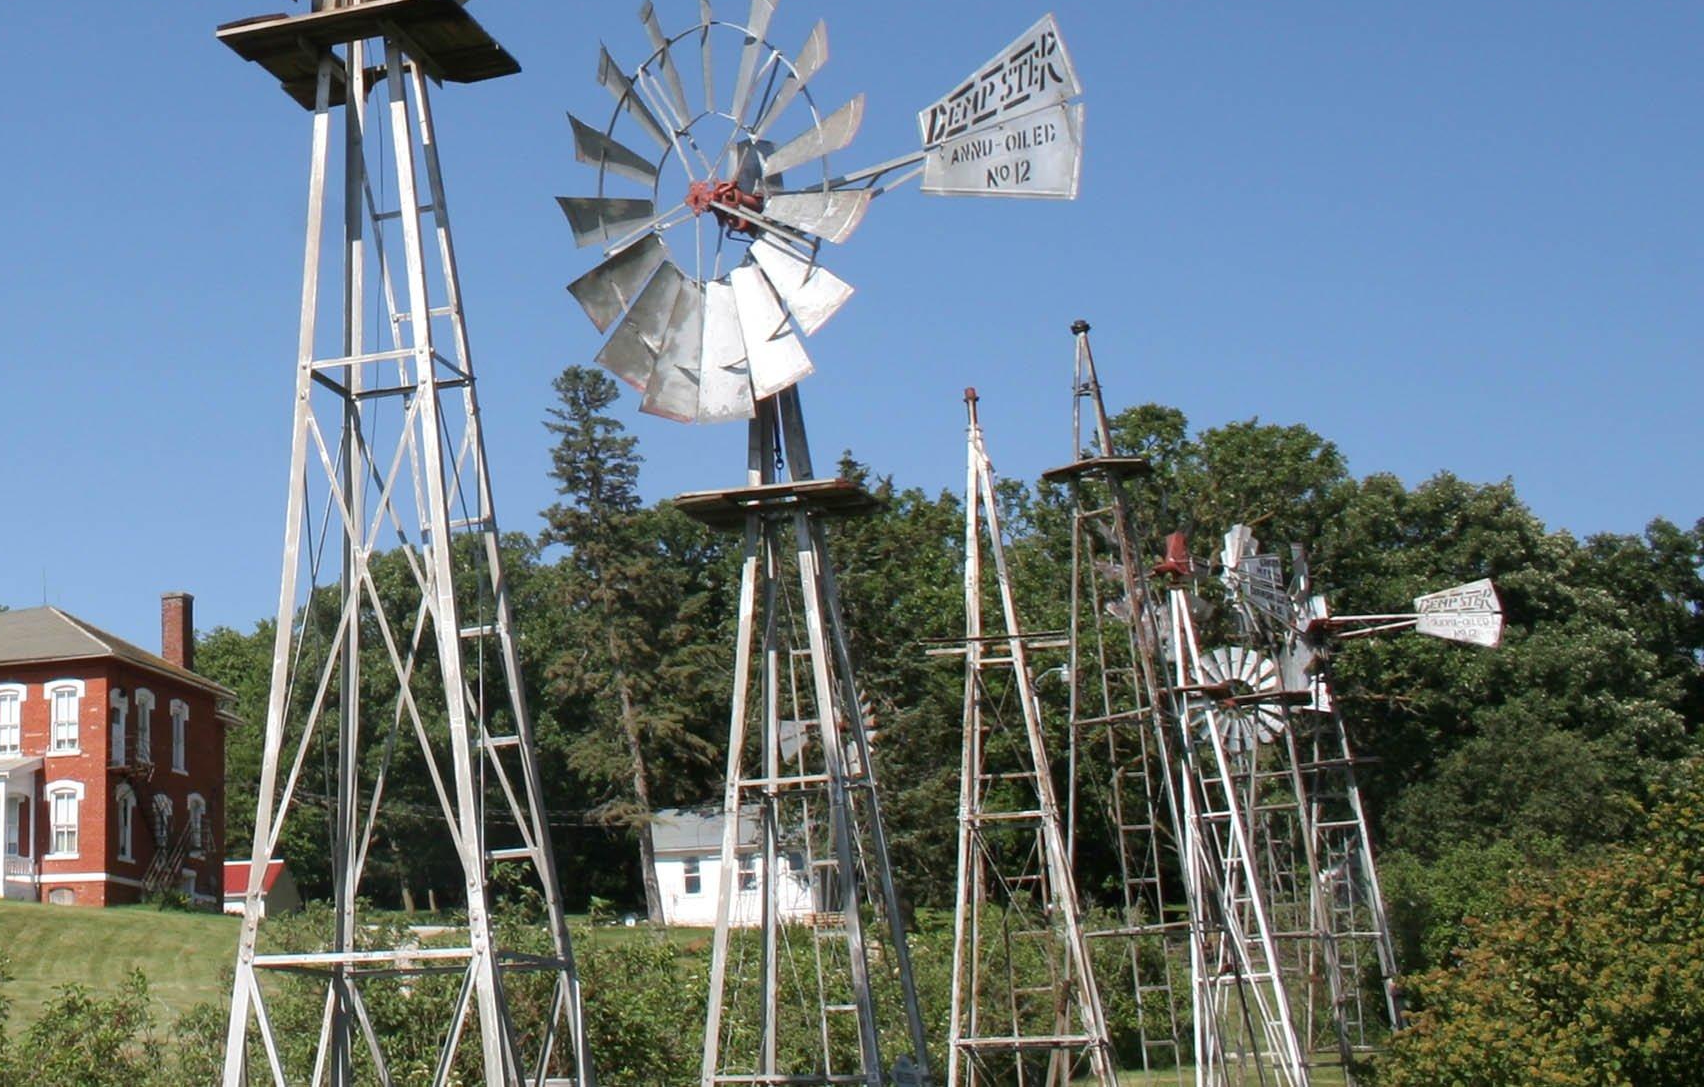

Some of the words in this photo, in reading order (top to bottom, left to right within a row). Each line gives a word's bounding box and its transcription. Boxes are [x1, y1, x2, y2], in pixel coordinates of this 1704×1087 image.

[925, 31, 1063, 145] DEMPSTER
[1015, 160, 1031, 185] 12
[1418, 588, 1493, 613] DEMPSTER
